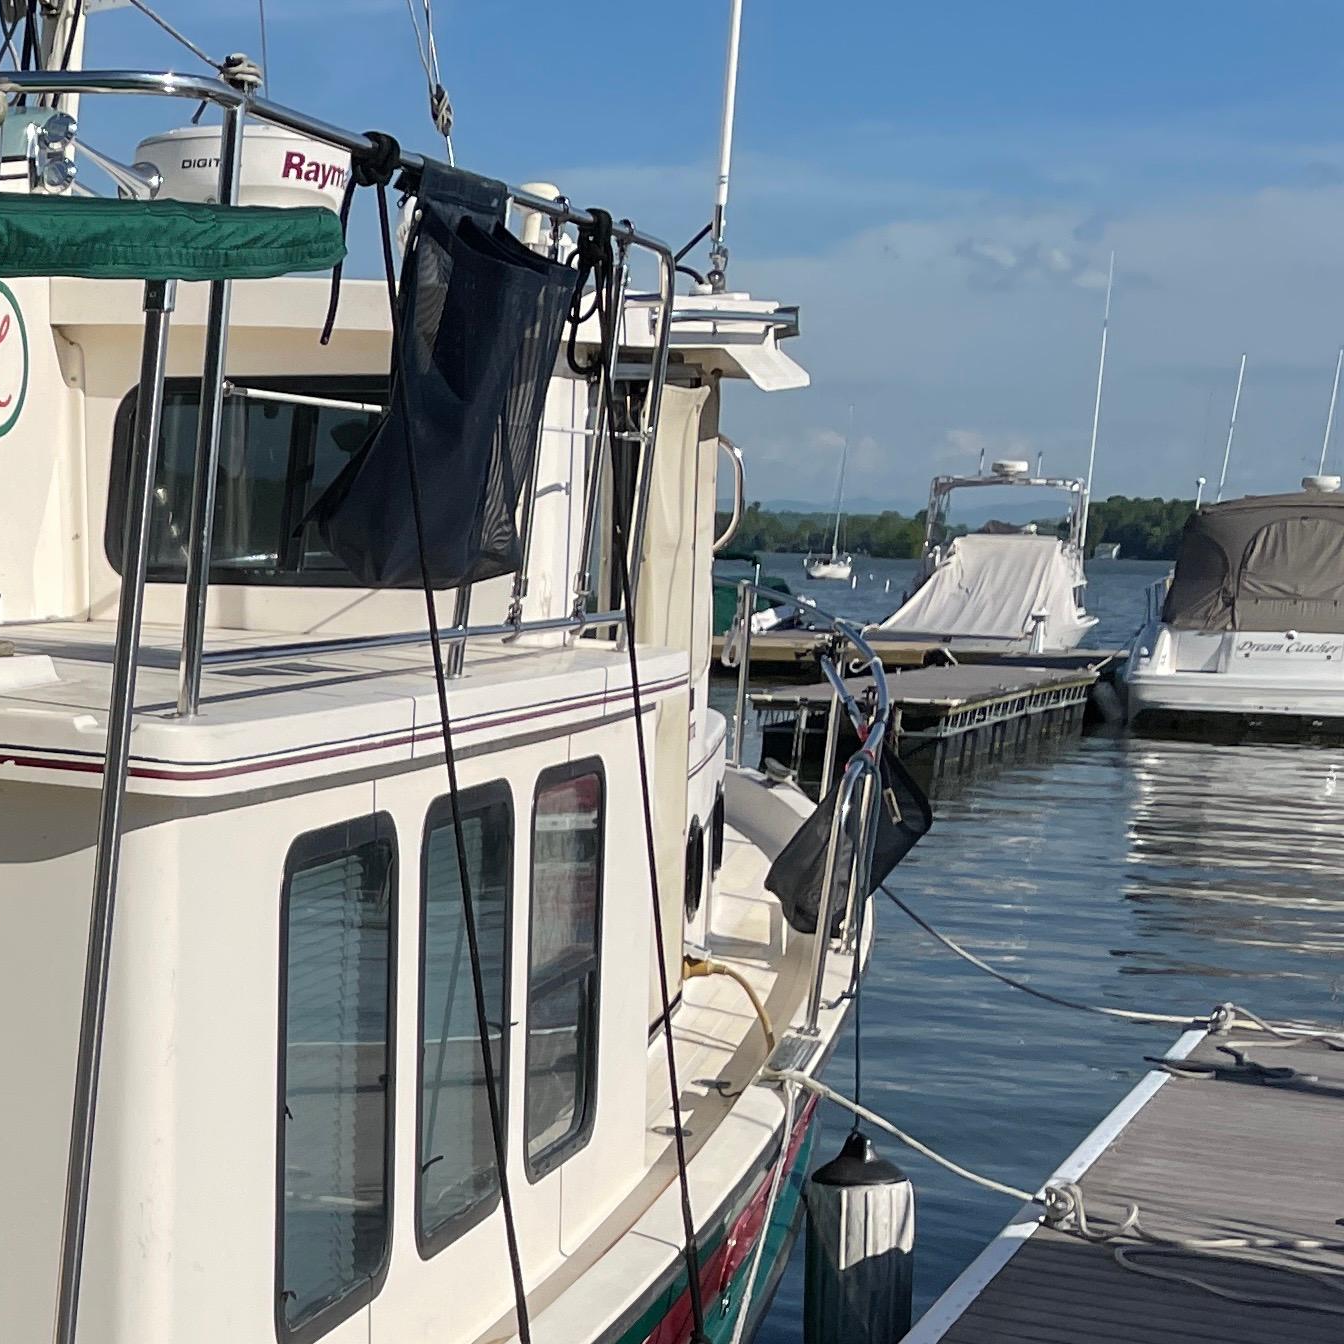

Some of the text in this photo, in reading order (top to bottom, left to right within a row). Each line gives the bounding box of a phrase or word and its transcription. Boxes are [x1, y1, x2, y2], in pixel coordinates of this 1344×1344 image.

[181, 158, 222, 169] DIGIT
[281, 150, 349, 190] Raym
[1236, 640, 1342, 654] Dream Catcher
